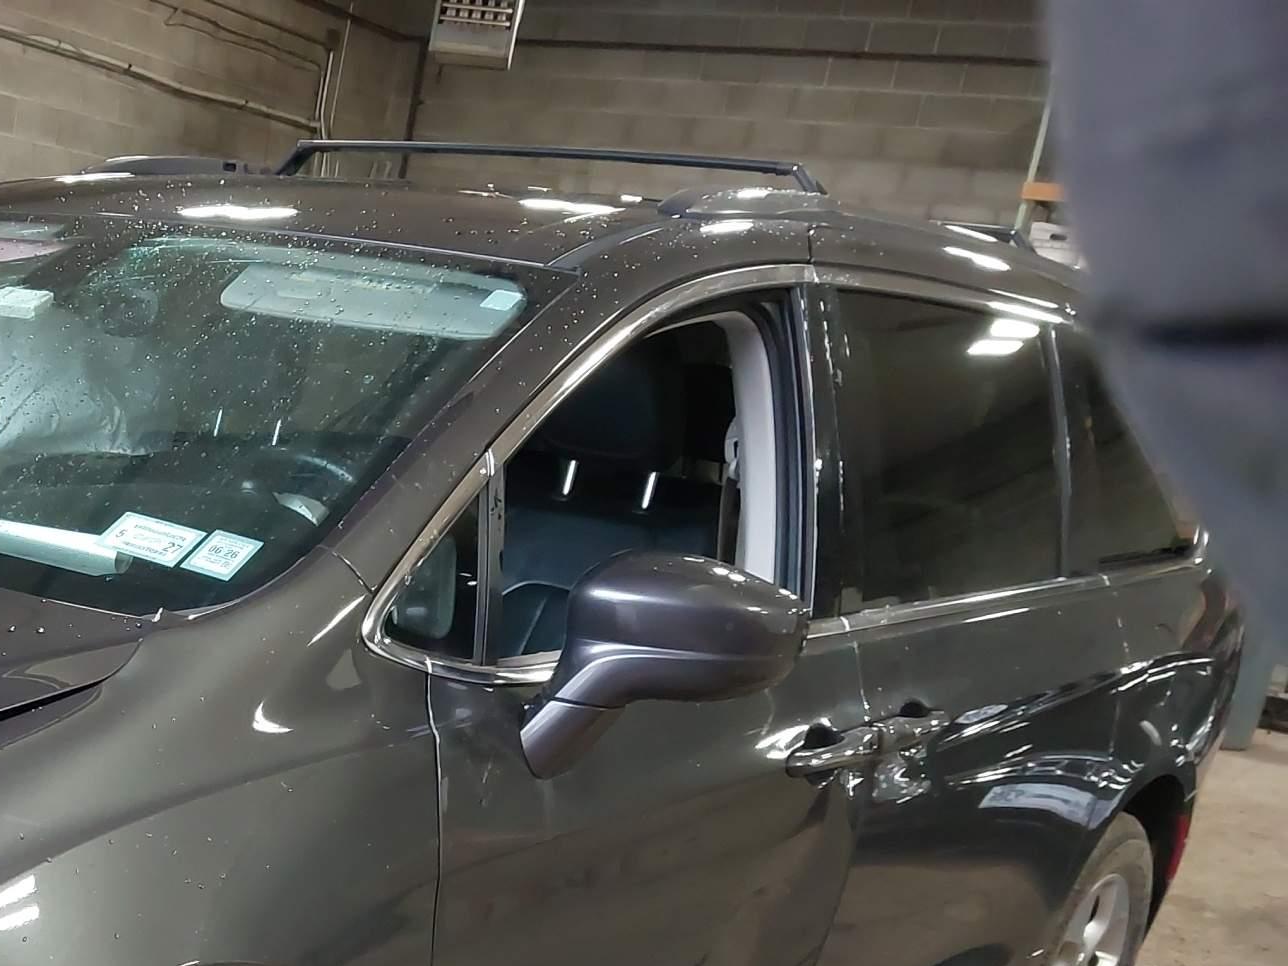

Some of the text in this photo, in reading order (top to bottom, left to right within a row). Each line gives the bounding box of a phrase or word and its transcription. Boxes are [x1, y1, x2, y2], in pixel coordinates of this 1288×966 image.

[162, 541, 183, 554] 27
[207, 544, 223, 555] 06
[223, 549, 241, 560] 26
